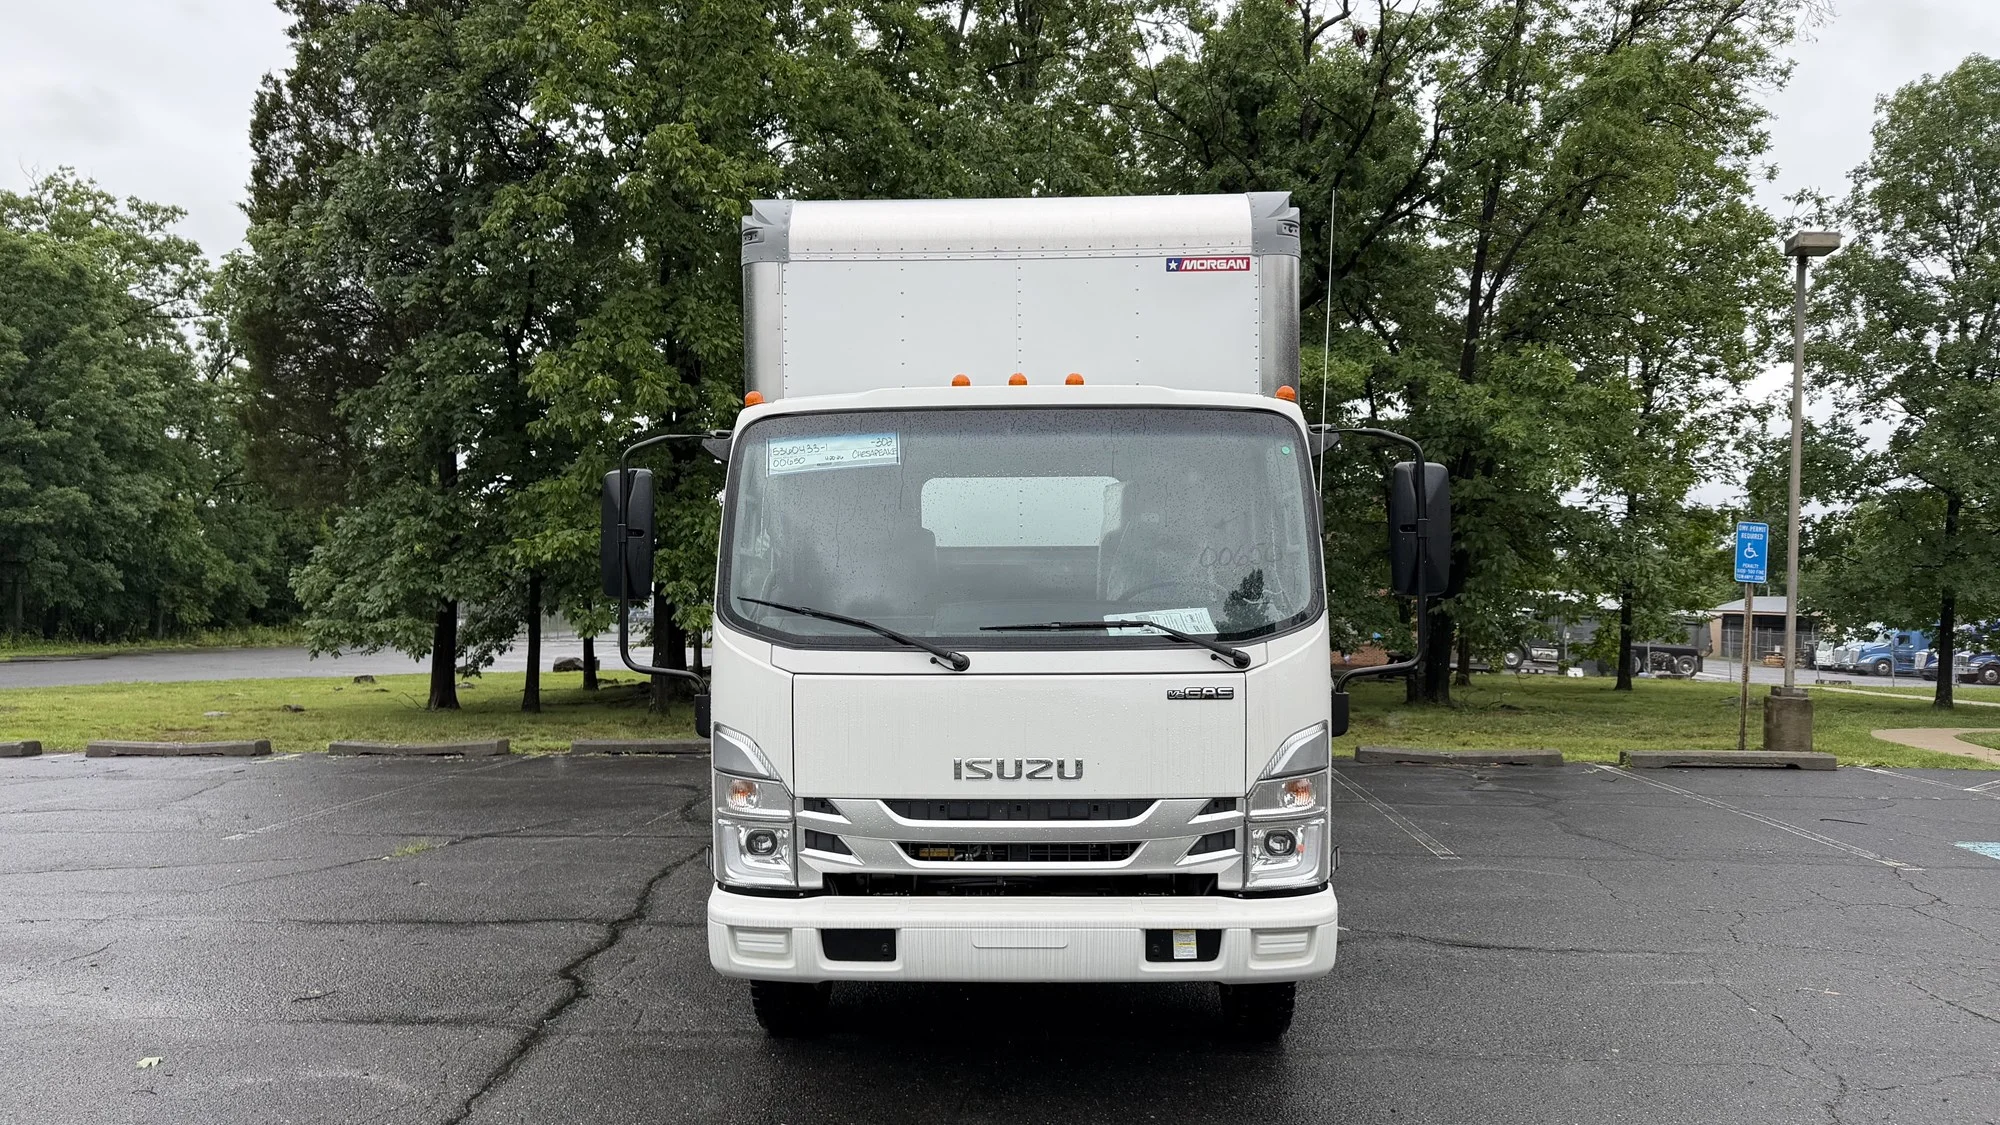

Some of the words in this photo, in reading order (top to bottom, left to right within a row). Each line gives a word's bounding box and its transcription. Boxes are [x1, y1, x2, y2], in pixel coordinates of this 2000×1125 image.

[1181, 259, 1248, 270] MORGAN
[773, 457, 806, 467] 00650
[1184, 687, 1234, 700] GAS
[954, 757, 1084, 780] ISUZU
